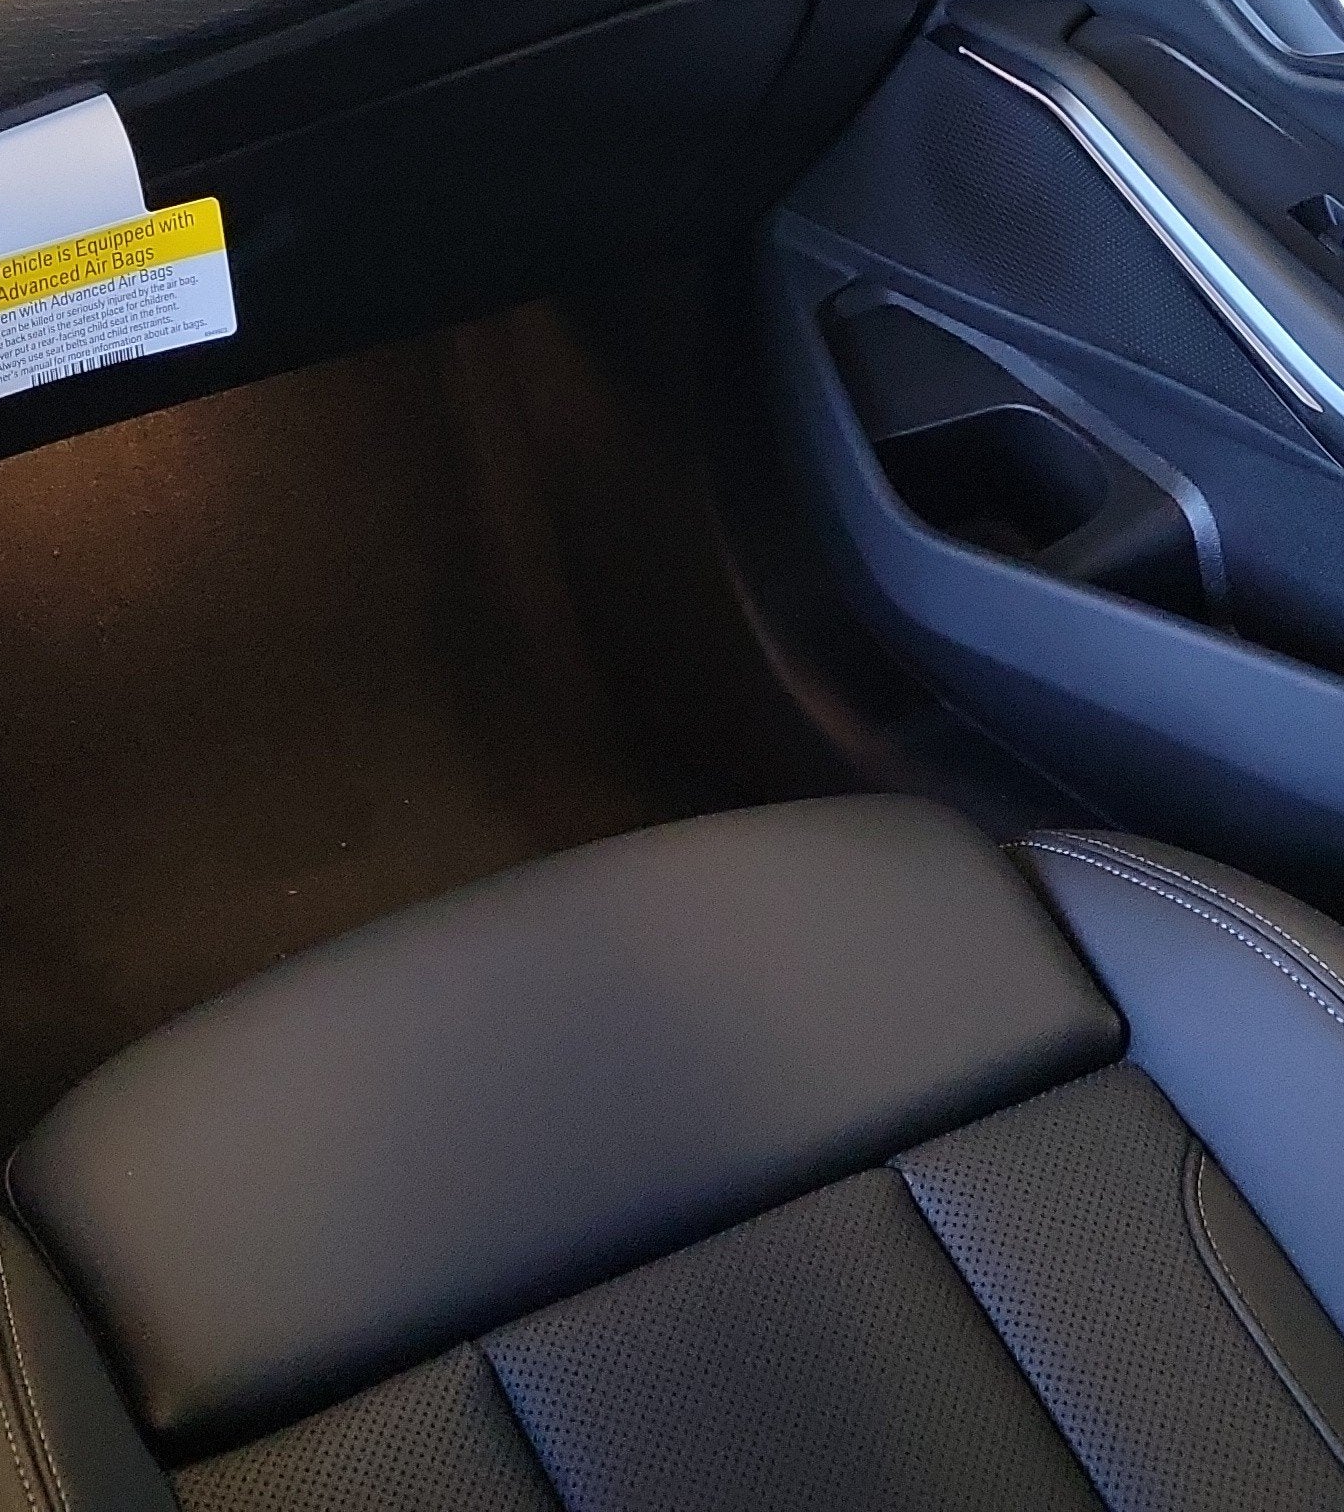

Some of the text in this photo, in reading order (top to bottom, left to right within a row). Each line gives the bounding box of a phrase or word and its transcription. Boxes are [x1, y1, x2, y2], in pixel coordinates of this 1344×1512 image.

[57, 245, 71, 262] is
[75, 219, 155, 257] Equipped
[158, 210, 194, 233] with
[85, 259, 108, 278] Air
[112, 247, 154, 269] Bags
[1, 327, 16, 337] can
[18, 323, 29, 331] be
[31, 315, 54, 328] killed
[56, 311, 64, 320] or
[67, 300, 105, 317] seriously
[107, 290, 136, 305] injured
[139, 288, 148, 298] by
[151, 283, 164, 293] the
[167, 280, 178, 288] air
[179, 275, 198, 286] bag.
[19, 299, 47, 318] with
[51, 277, 115, 308] Advanced
[119, 274, 136, 289] Air
[140, 266, 173, 283] Bags
[5, 333, 26, 347] back
[27, 328, 46, 340] seat
[48, 324, 55, 333] is
[57, 321, 71, 331] the
[73, 312, 99, 326] safest
[101, 306, 124, 319] place
[126, 301, 137, 311] for
[140, 292, 177, 307] children.
[15, 344, 29, 356] put
[38, 328, 86, 348] rear-facing
[87, 321, 108, 333] child
[110, 315, 128, 327] seat
[130, 313, 138, 321] in
[140, 308, 154, 318] the
[156, 302, 179, 314] front.
[28, 351, 43, 362] use
[46, 345, 64, 357] seat
[66, 338, 87, 350] belts
[89, 332, 105, 344] and
[107, 325, 128, 338] child
[130, 316, 173, 333] restraints.
[20, 358, 52, 375] manual
[54, 356, 65, 365] for
[67, 349, 90, 361] more
[92, 336, 141, 354] information
[143, 329, 169, 340] about
[170, 325, 181, 334] air
[183, 319, 207, 331] bags.
